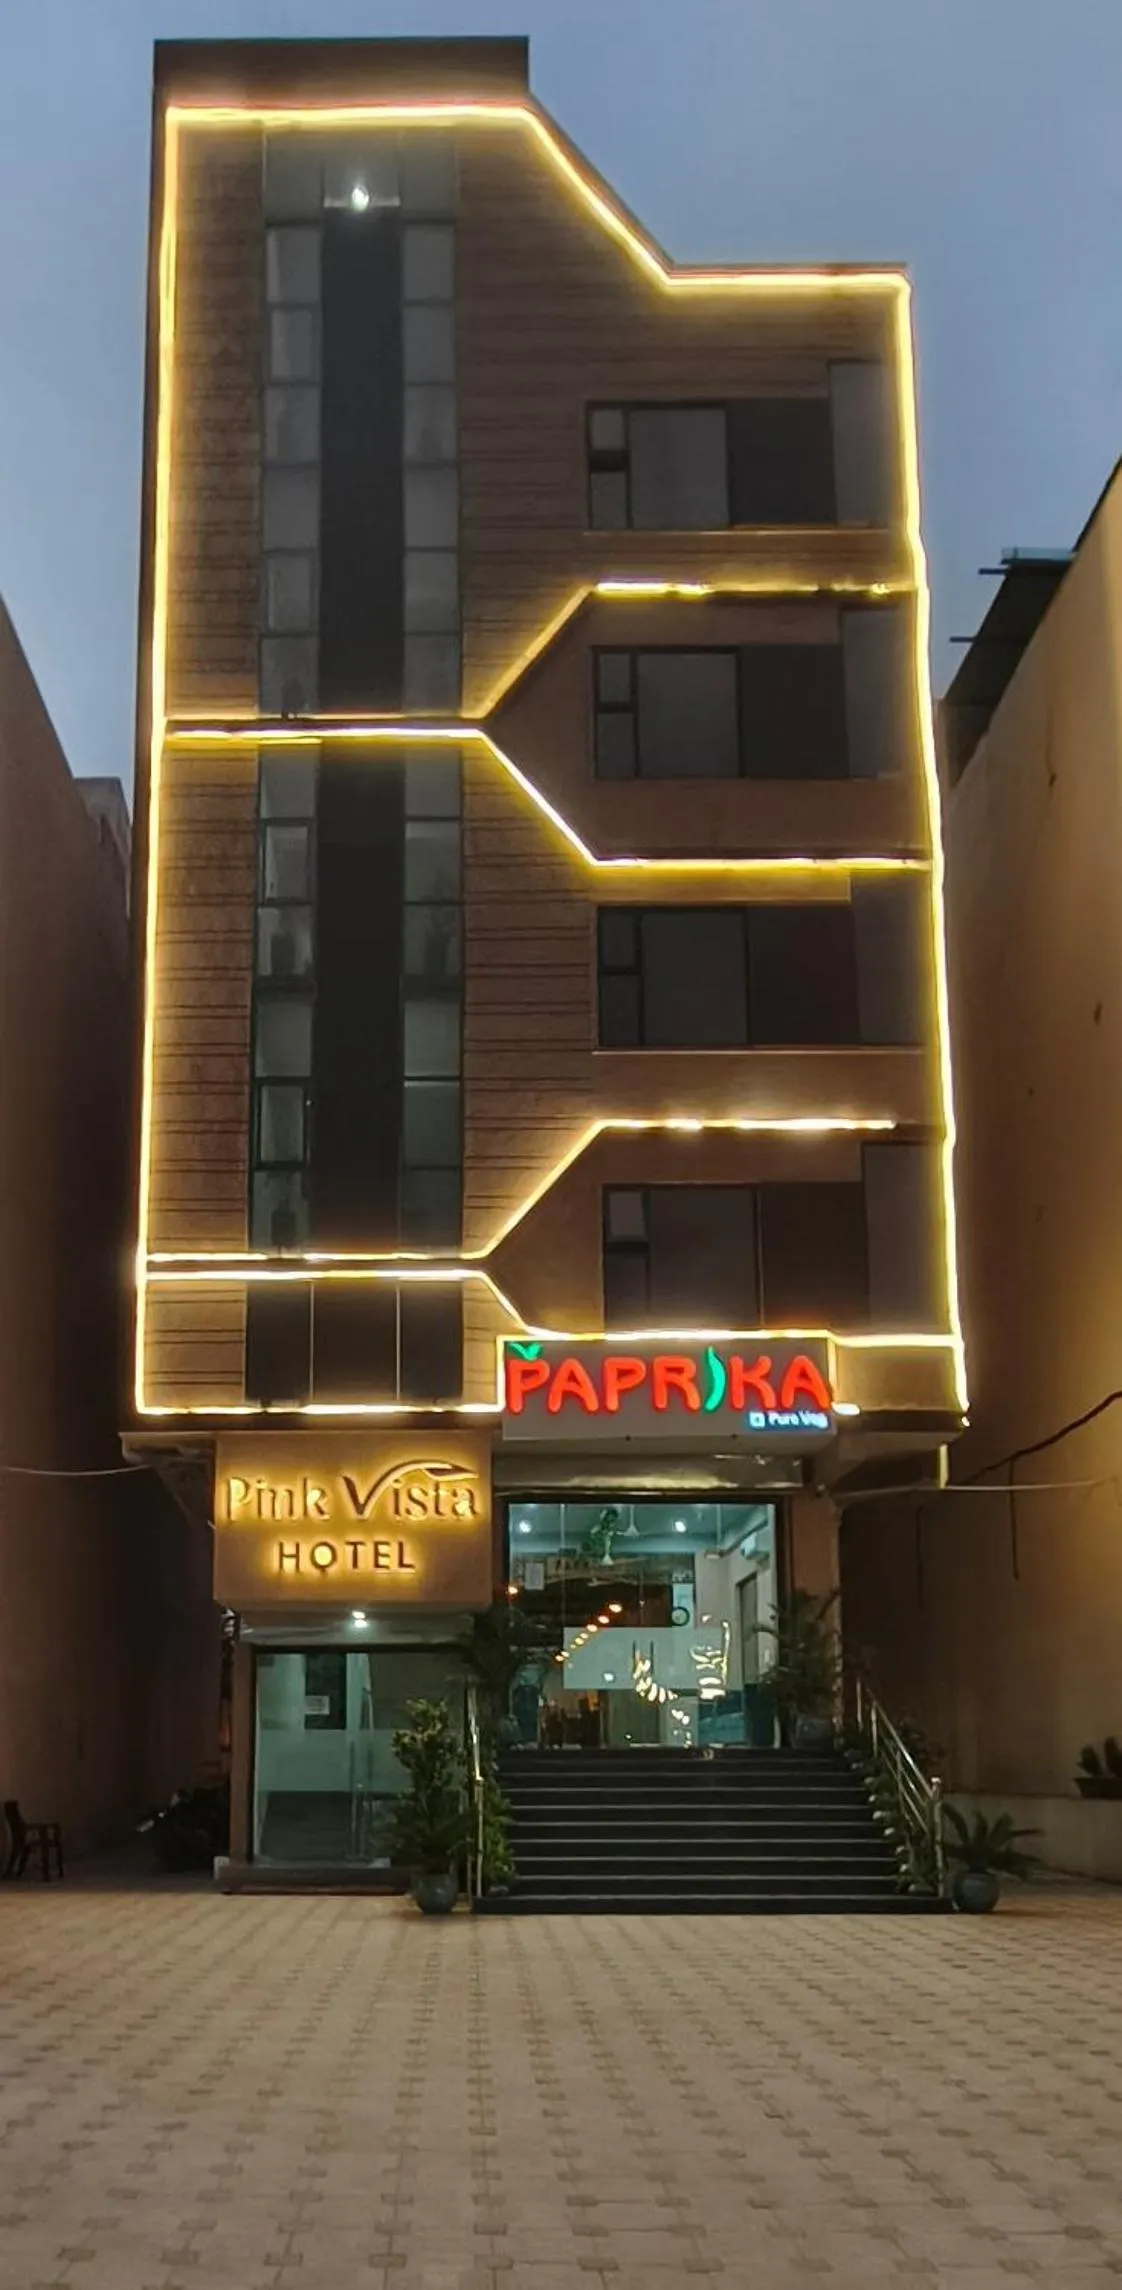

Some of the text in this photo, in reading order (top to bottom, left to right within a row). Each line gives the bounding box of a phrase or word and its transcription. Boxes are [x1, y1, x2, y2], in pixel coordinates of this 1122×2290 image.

[505, 1343, 831, 1413] PAPRIKA
[768, 1410, 799, 1426] Pure
[226, 1459, 479, 1522] Pink Vista
[277, 1541, 416, 1573] HOTEL
